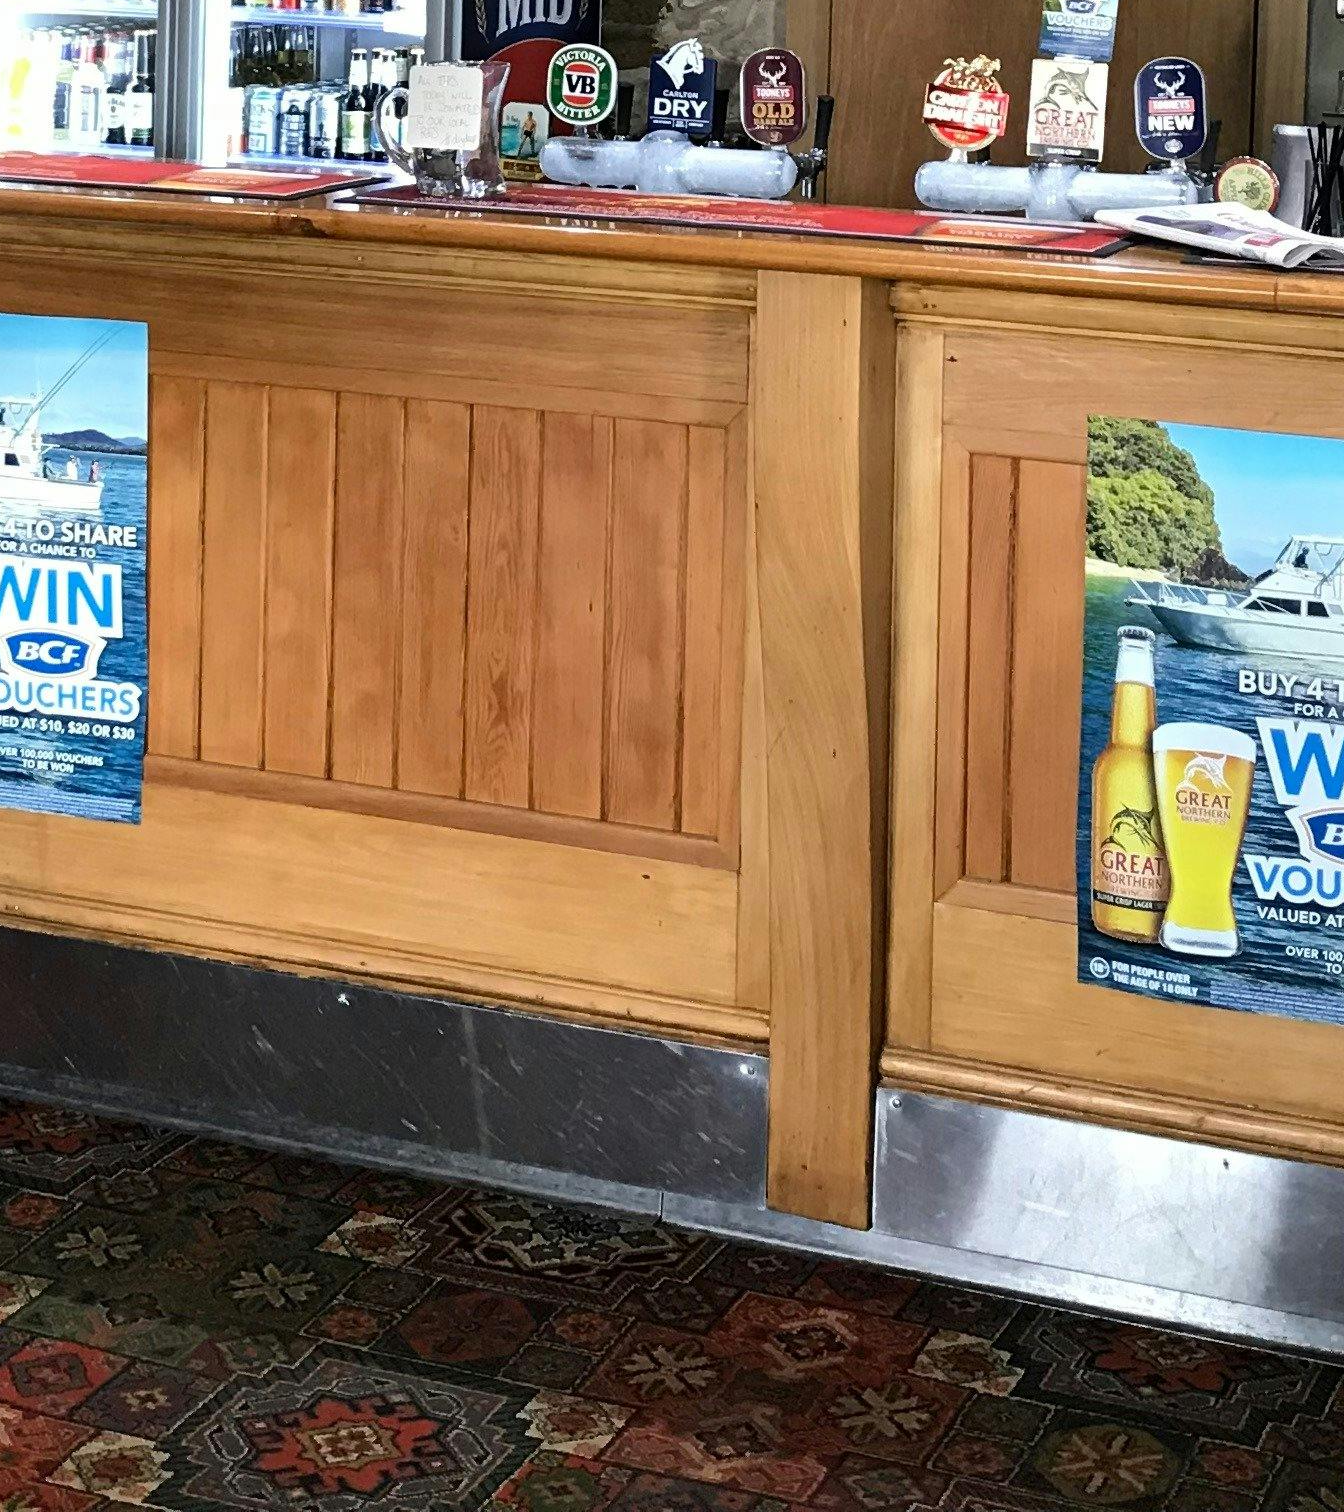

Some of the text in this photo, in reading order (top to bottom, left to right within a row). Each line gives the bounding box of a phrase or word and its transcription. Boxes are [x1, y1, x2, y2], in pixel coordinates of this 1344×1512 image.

[556, 50, 607, 71] VICTORIA
[565, 73, 596, 95] VB
[663, 89, 698, 99] CARLTON
[557, 103, 601, 119] BITTER
[653, 98, 708, 118] DRY
[752, 102, 795, 118] OLD
[1034, 107, 1099, 127] GREAT
[1148, 115, 1195, 131] NEW
[4, 517, 17, 537] 4
[24, 519, 55, 540] TO
[61, 522, 137, 547] SHARE
[19, 542, 28, 553] A
[30, 543, 77, 556] CHANCE
[79, 547, 96, 558] TO
[16, 640, 81, 665] BCF
[1238, 669, 1299, 697] BUY
[1306, 678, 1324, 701] 4
[1294, 703, 1324, 719] FOR
[1327, 707, 1338, 719] A
[22, 718, 37, 730] AT
[39, 719, 65, 734] $10,
[68, 721, 90, 735] $20
[92, 724, 110, 739] OR
[112, 726, 135, 740] $30
[20, 748, 54, 760] 100,000
[56, 753, 103, 766] VOUCHERS
[22, 759, 74, 773] TO BE WON
[1175, 789, 1232, 809] GREAT
[1176, 806, 1231, 820] NORTHERN
[1100, 849, 1165, 877] GREAT
[1102, 869, 1164, 889] NORTHERN
[1257, 905, 1321, 926] VALUED
[1285, 945, 1319, 960] OVER
[1131, 964, 1164, 979] PEOPLE
[1166, 971, 1190, 984] OVER
[1325, 962, 1343, 975] TO
